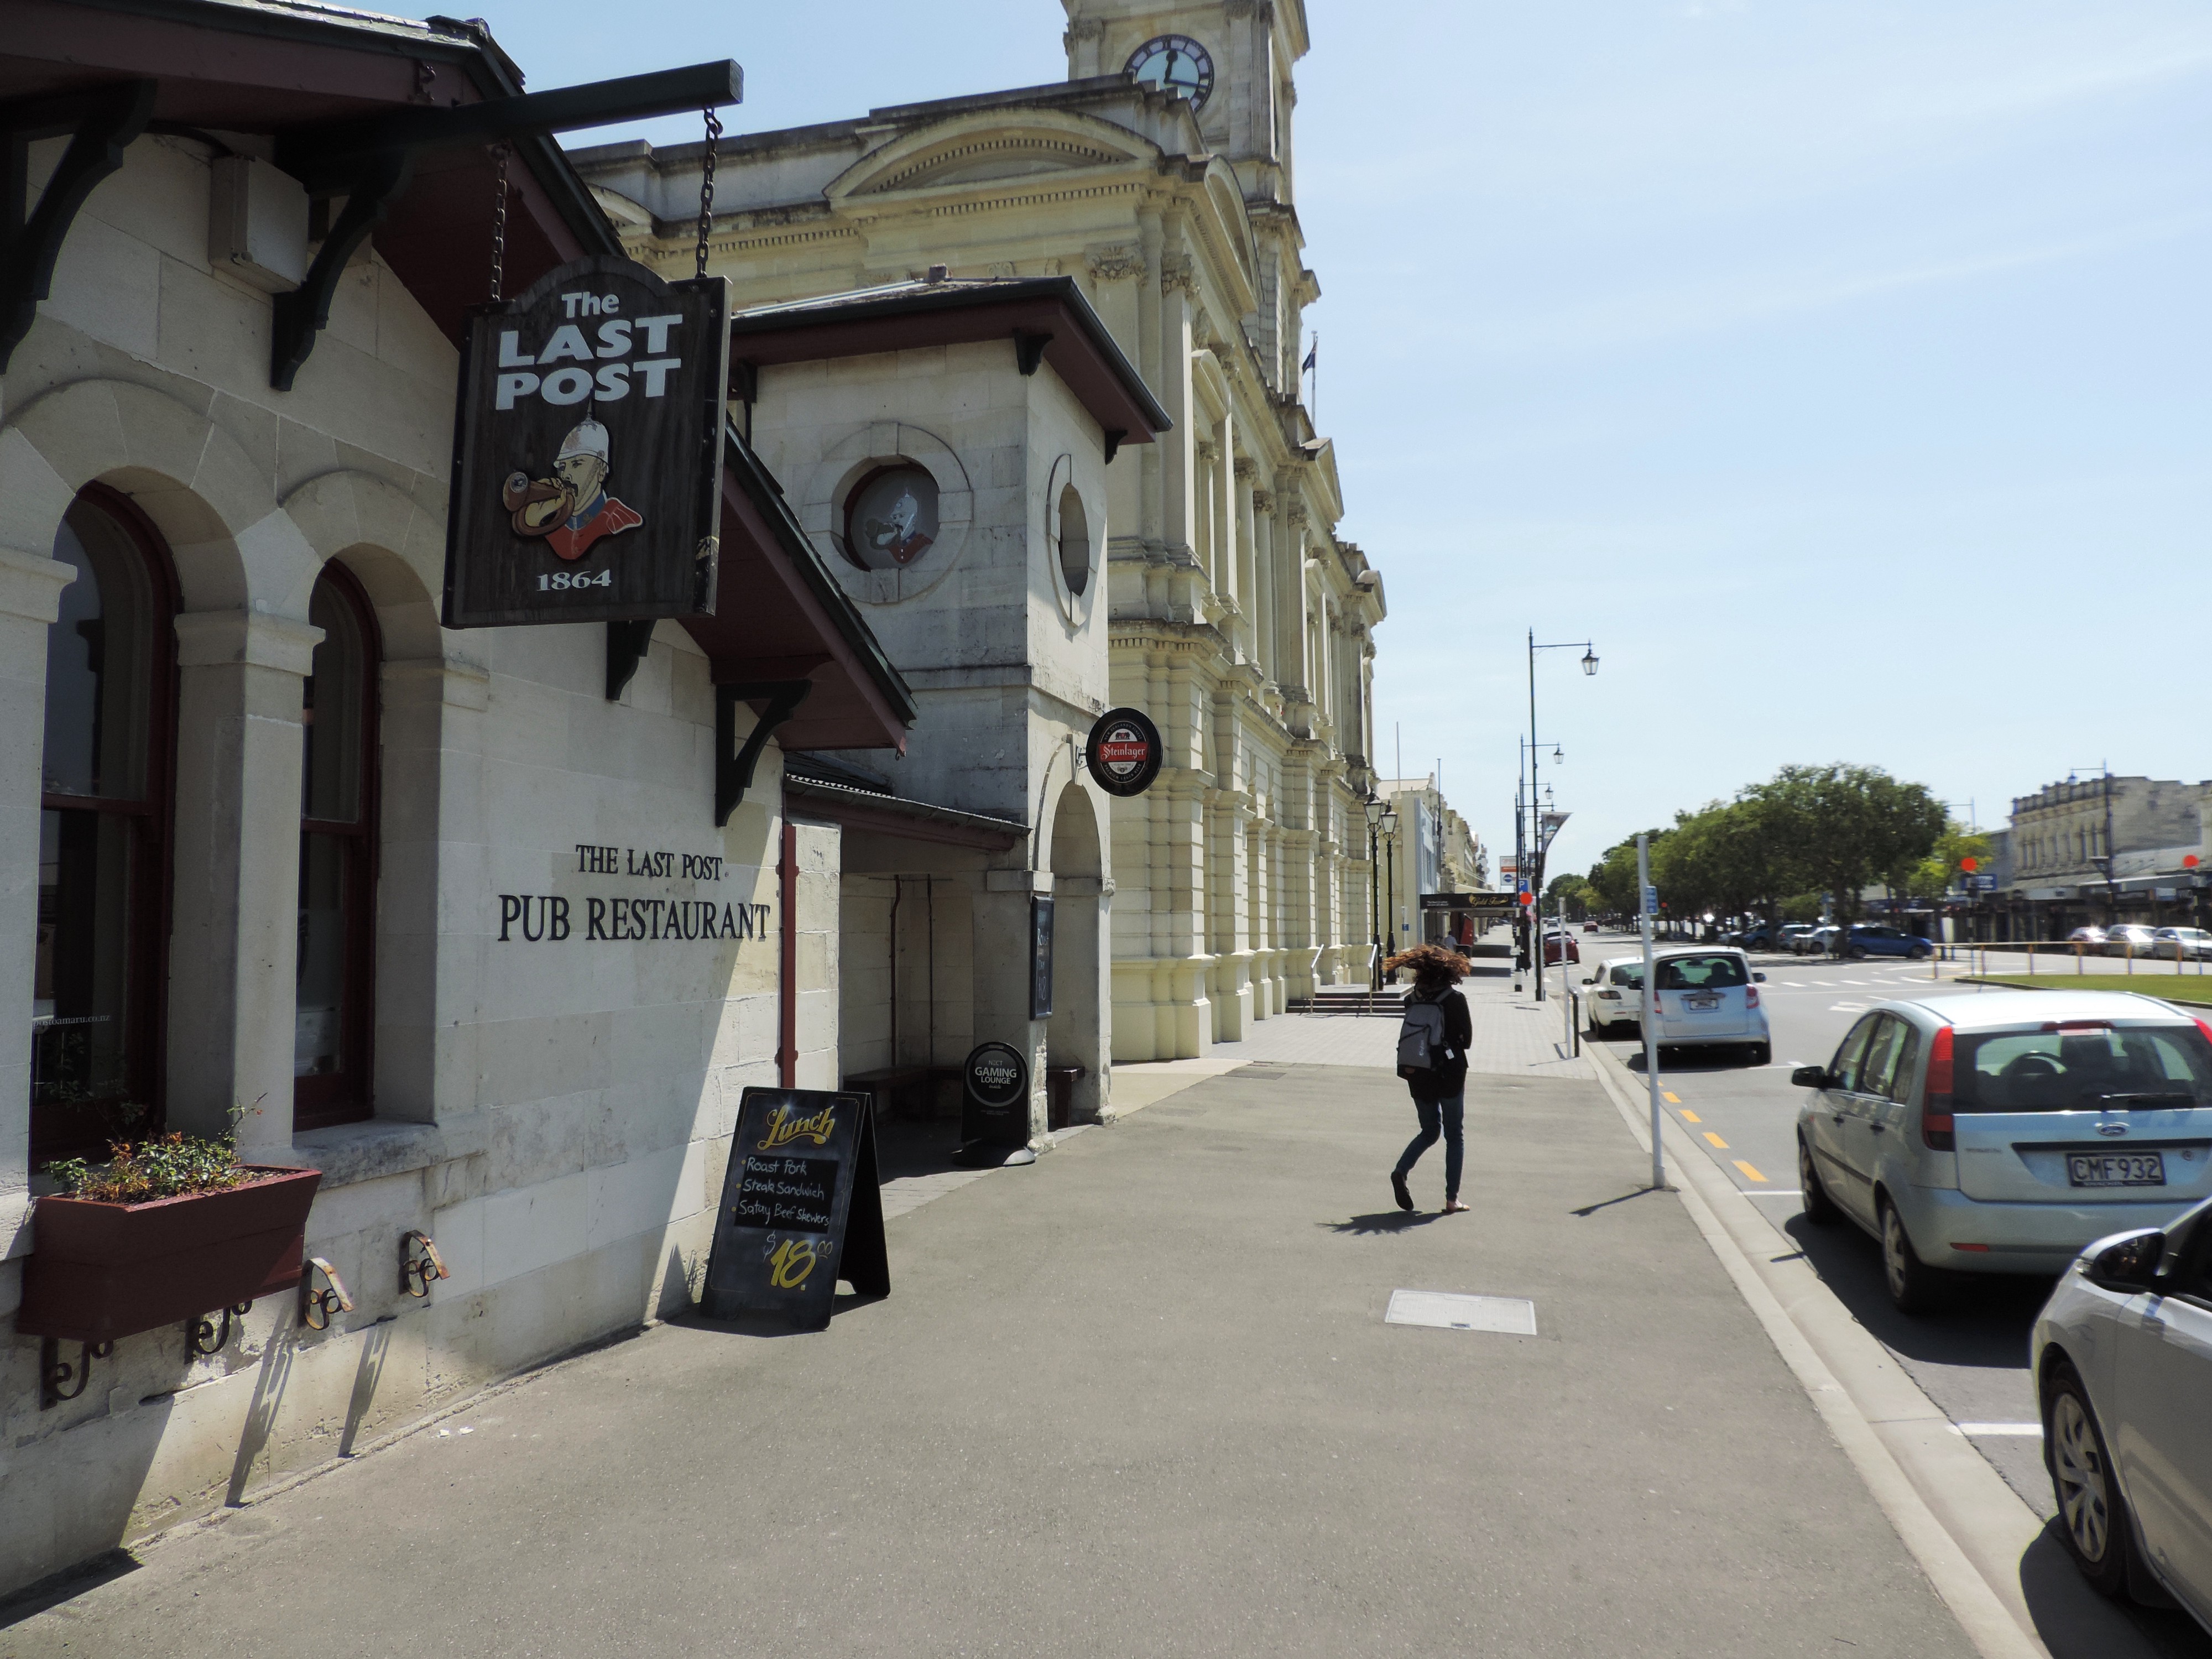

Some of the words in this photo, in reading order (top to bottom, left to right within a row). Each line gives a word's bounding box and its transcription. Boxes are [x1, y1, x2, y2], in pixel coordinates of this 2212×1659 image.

[561, 291, 619, 318] The
[498, 314, 683, 367] LAST
[495, 358, 681, 410] POST
[536, 569, 612, 591] 1864
[1101, 743, 1145, 760] Steinlager
[576, 844, 618, 874] THE
[627, 849, 675, 877] LAST
[682, 854, 722, 881] POST
[498, 895, 570, 941] PUB
[586, 898, 770, 940] RESTAURANT
[975, 1067, 1017, 1078] GAMING
[980, 1076, 1011, 1084] LOUNGE
[757, 1104, 835, 1150] Lunch
[747, 1156, 780, 1173] Roast
[784, 1159, 807, 1176] Pork
[2074, 1157, 2160, 1181] CMF932
[742, 1178, 775, 1194] Steak
[776, 1182, 825, 1201] Sandwich
[738, 1199, 771, 1225] Satay
[774, 1203, 796, 1219] Beef
[796, 1208, 830, 1227] Skewers
